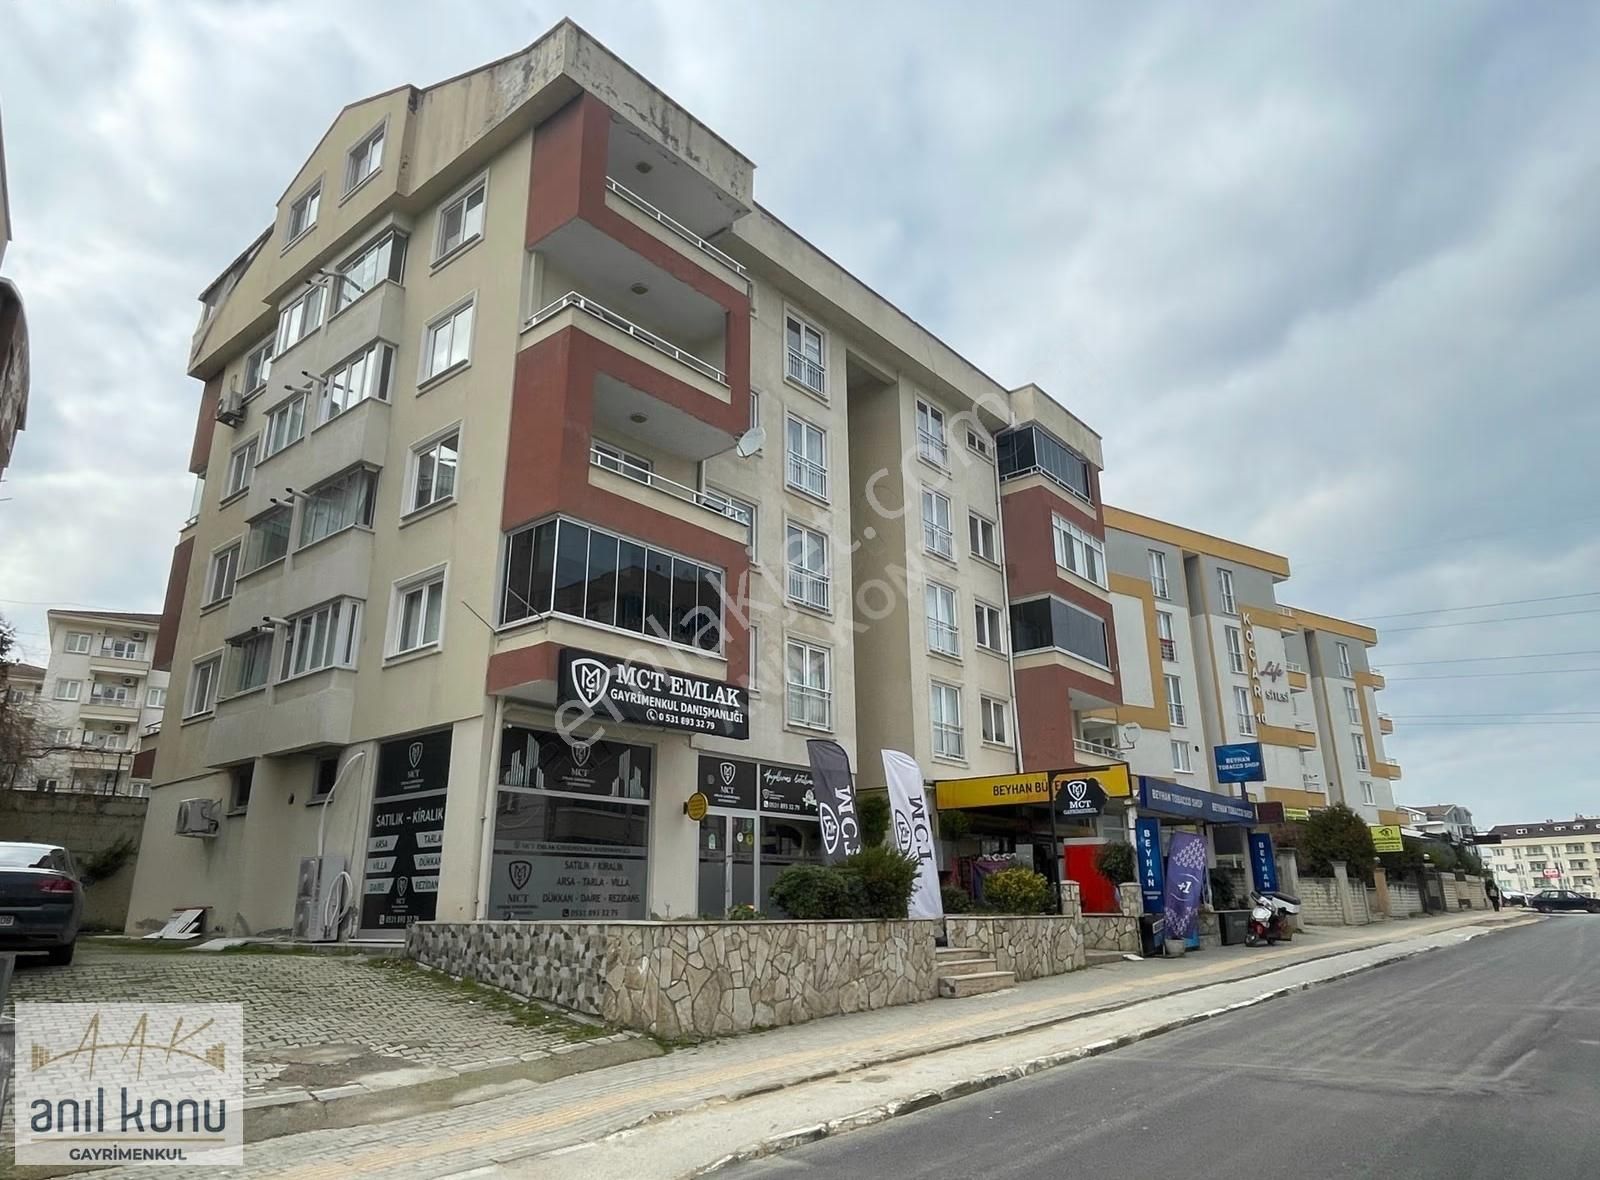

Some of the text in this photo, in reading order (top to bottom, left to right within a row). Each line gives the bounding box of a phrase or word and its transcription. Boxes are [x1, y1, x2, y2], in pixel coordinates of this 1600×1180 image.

[616, 664, 740, 707] MCT EMLAK
[610, 688, 743, 723] GAYRİMENKUL DANIŞMANLIĞI
[658, 713, 715, 730] 0 531 893 32 79
[993, 784, 1032, 796] BEYHAN
[1069, 800, 1092, 808] MCT
[376, 809, 404, 828] SATILIK
[412, 807, 443, 824] KİRALIK
[1143, 829, 1155, 887] BEYHAN
[1258, 841, 1270, 888] BEYHAN
